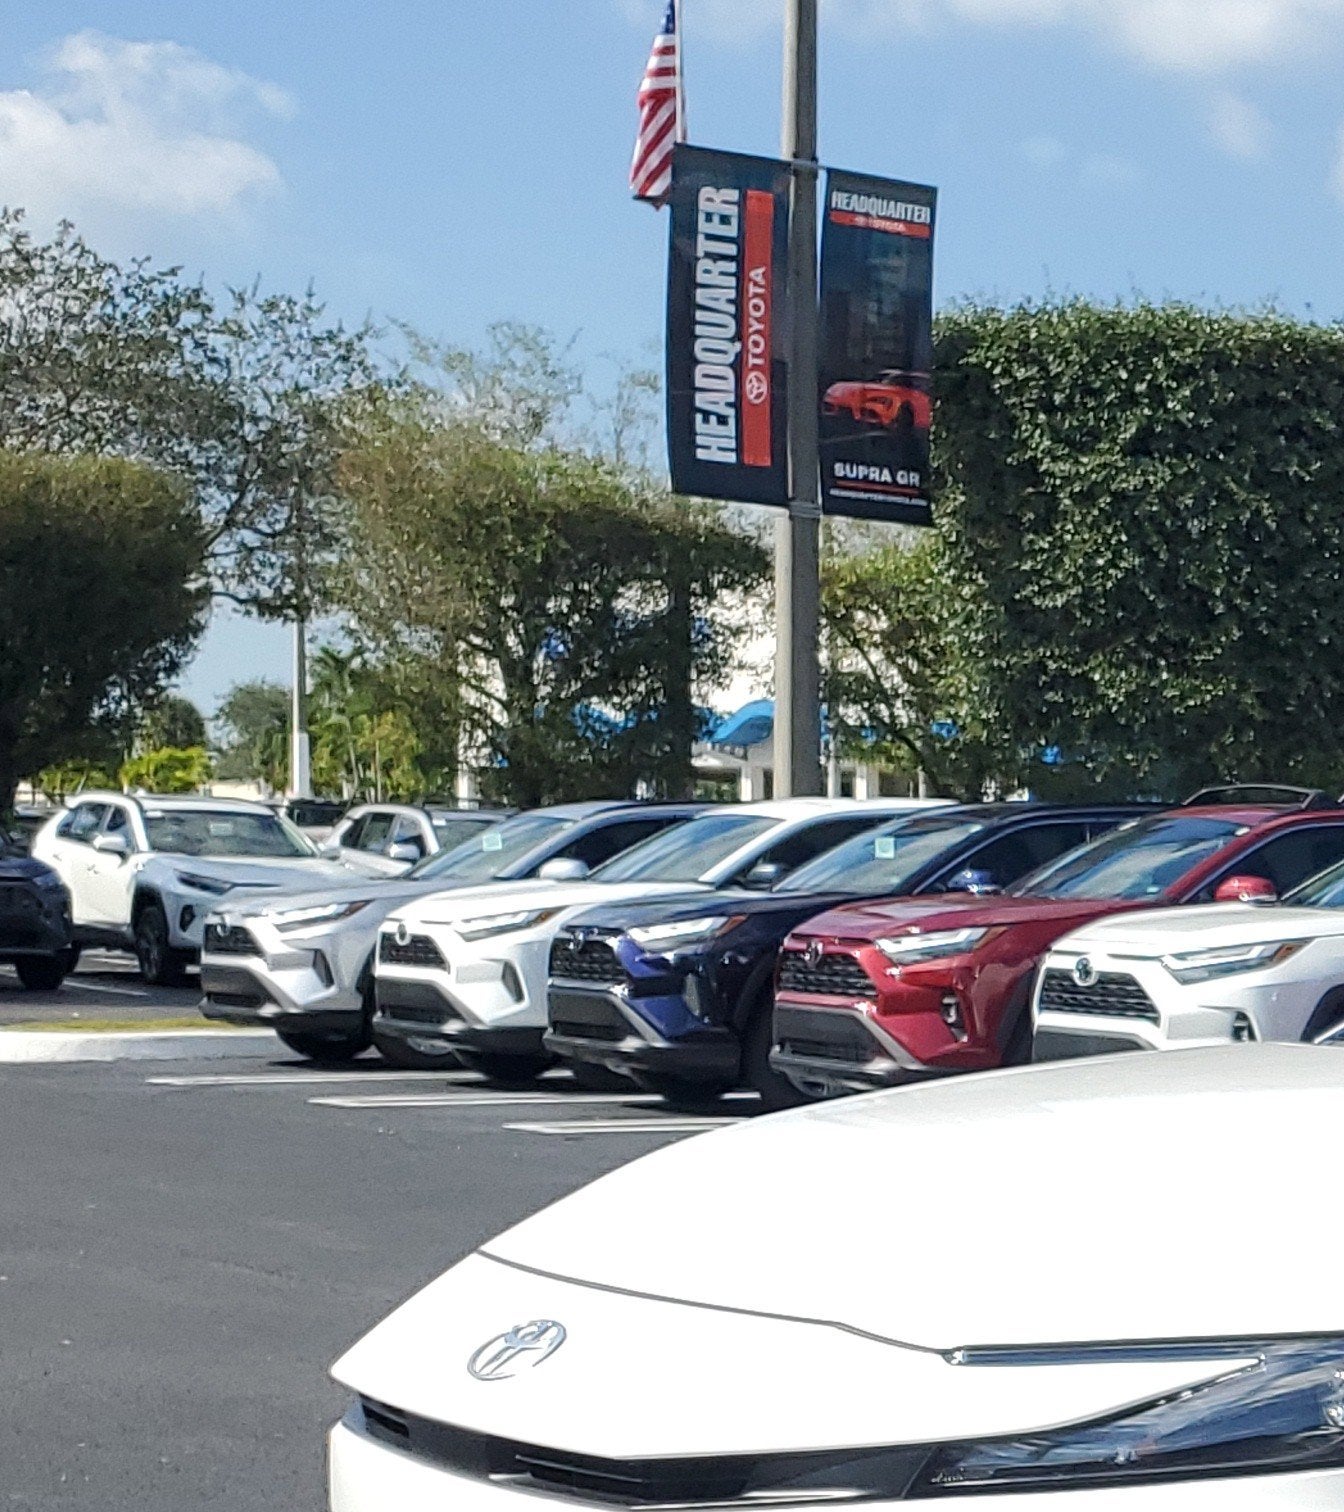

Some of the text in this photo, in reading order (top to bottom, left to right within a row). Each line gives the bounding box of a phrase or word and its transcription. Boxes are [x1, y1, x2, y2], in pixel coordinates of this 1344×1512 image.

[831, 190, 931, 224] HEADQUARTER
[694, 185, 741, 464] HEADQUARTER
[747, 266, 767, 367] TOYOTA
[834, 461, 920, 488] SUPRA GR
